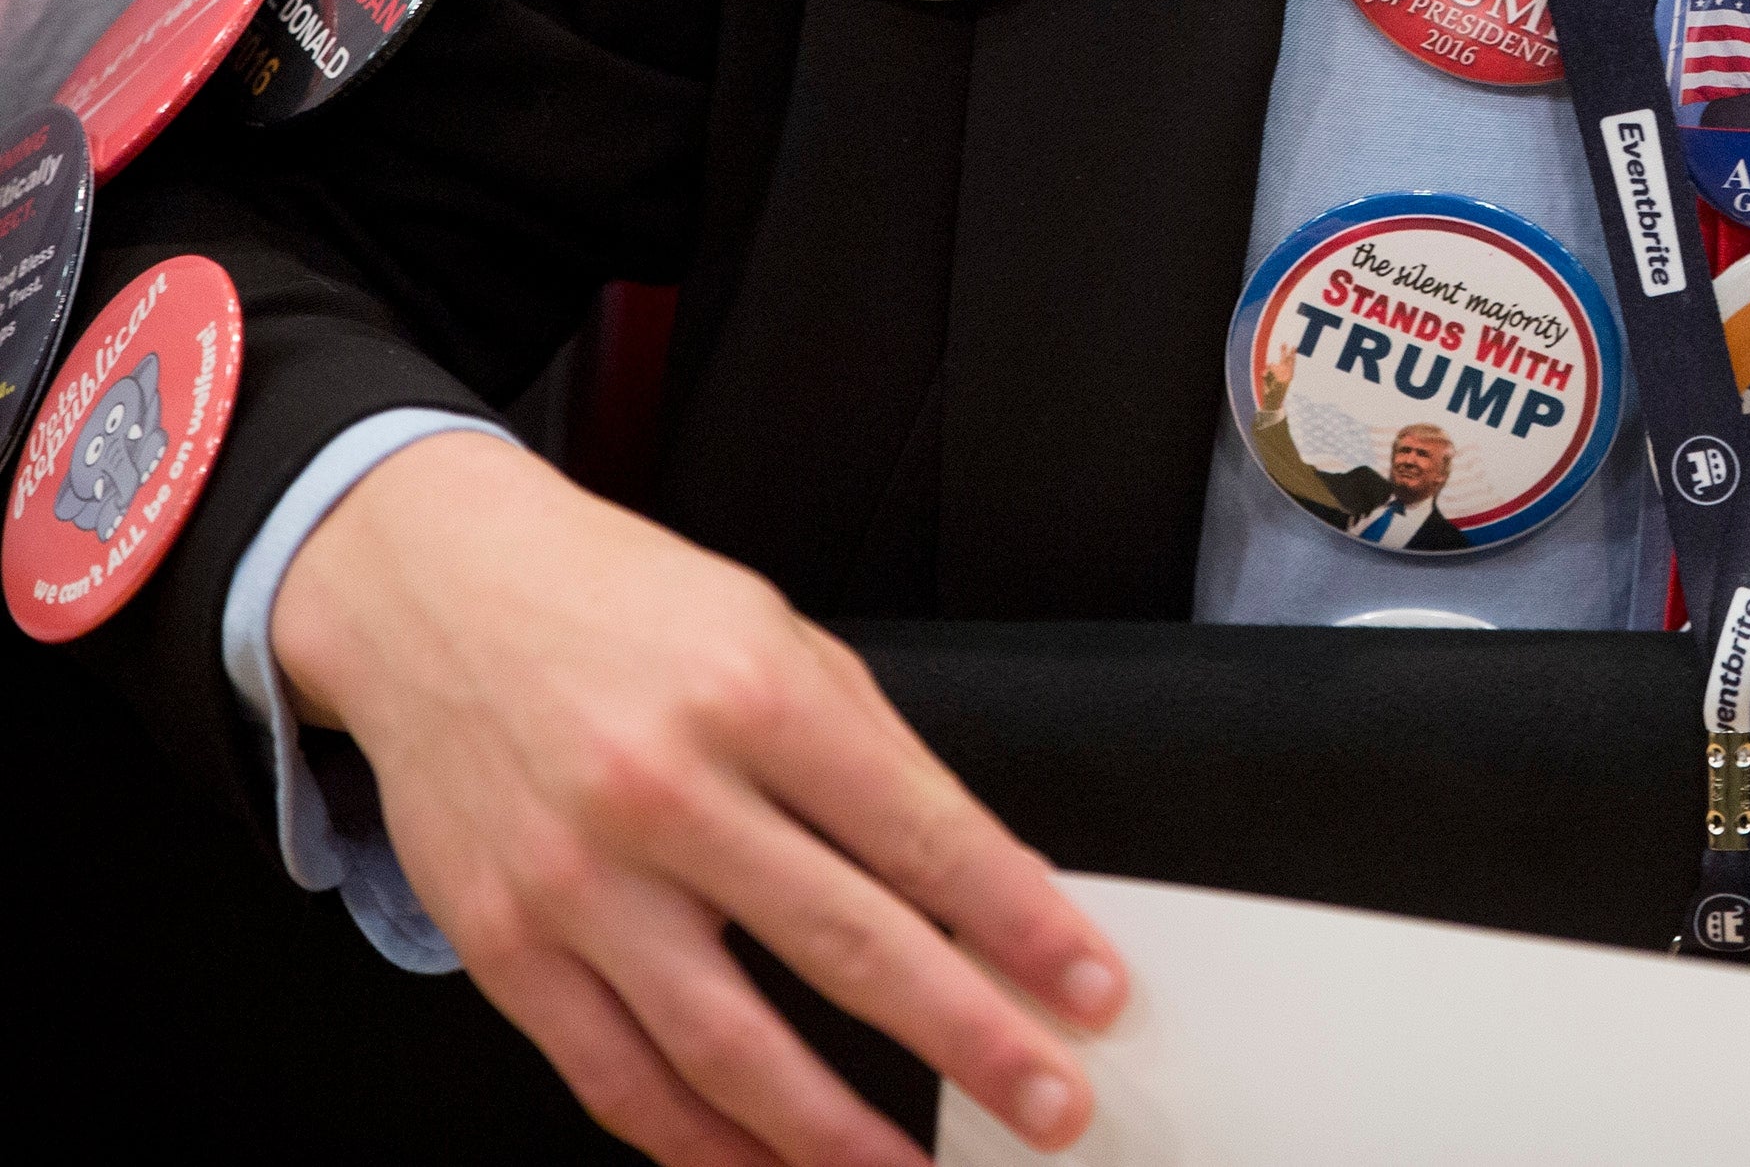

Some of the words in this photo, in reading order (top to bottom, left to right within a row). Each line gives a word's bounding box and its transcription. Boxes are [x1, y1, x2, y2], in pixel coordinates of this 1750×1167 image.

[1420, 28, 1479, 66] 2016
[1618, 122, 1670, 286] Eventbrite
[1322, 268, 1466, 352] STANDS
[1473, 325, 1575, 392] WITH
[1352, 242, 1394, 278] the
[1393, 262, 1468, 305] silent
[1465, 293, 1570, 349] majority
[13, 272, 168, 520] Republican
[29, 380, 80, 459] Vote
[1296, 301, 1567, 440] TRUMP
[33, 579, 58, 605] we
[107, 525, 147, 576] ALL
[143, 484, 172, 522] be
[169, 441, 193, 480] on
